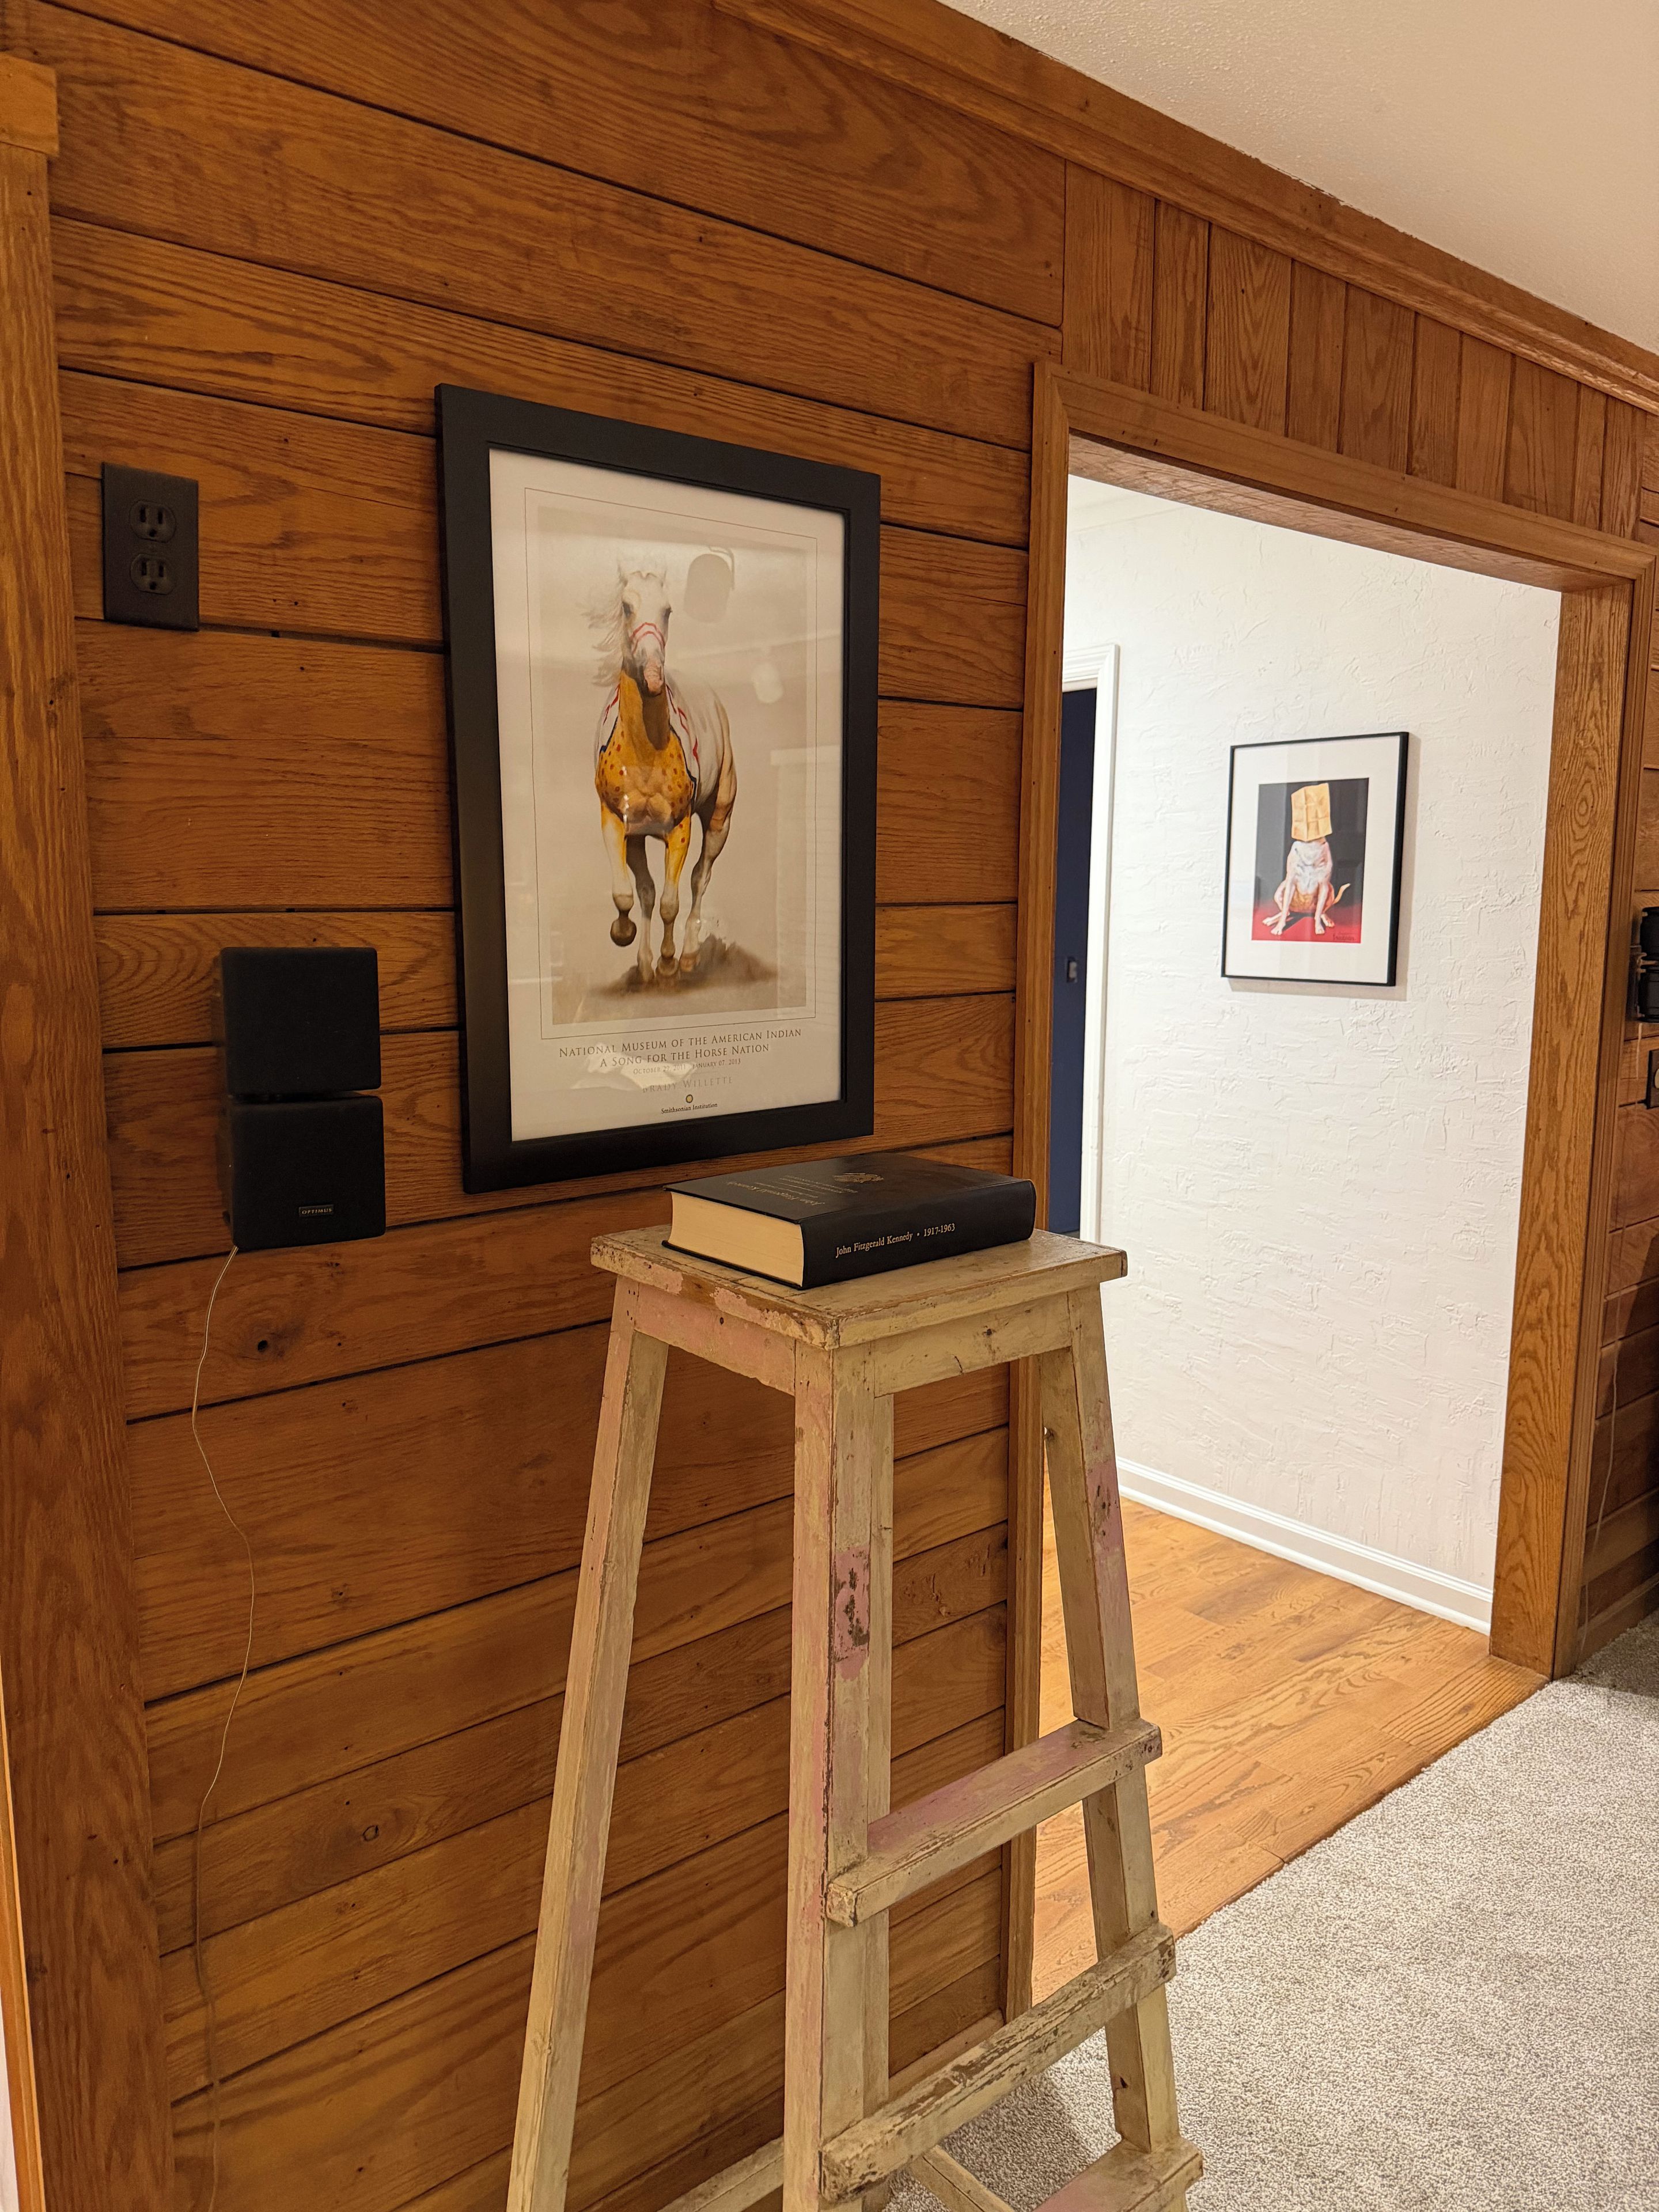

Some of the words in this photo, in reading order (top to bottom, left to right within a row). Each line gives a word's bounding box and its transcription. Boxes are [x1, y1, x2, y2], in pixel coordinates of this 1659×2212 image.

[559, 1044, 617, 1057] NATIONAL
[622, 1040, 667, 1052] MUSEUM
[671, 1039, 684, 1047] OF
[688, 1037, 707, 1046] THE
[711, 1032, 762, 1044] AMERICAN
[767, 1028, 801, 1039] INDIAN
[600, 1058, 607, 1067] A
[612, 1055, 642, 1066] SONG
[647, 1053, 667, 1063] FOR
[671, 1051, 690, 1061] THE
[695, 1047, 728, 1059] HORSE
[732, 1044, 769, 1055] NATION
[633, 1066, 661, 1075] OCTOBER
[661, 1105, 691, 1114] Smithsonian
[692, 1103, 718, 1111] Institution
[835, 1247, 852, 1259] John
[853, 1237, 885, 1252] Fitzgerald
[887, 1232, 913, 1245] Kennedy
[923, 1223, 956, 1237] 1917-1963
